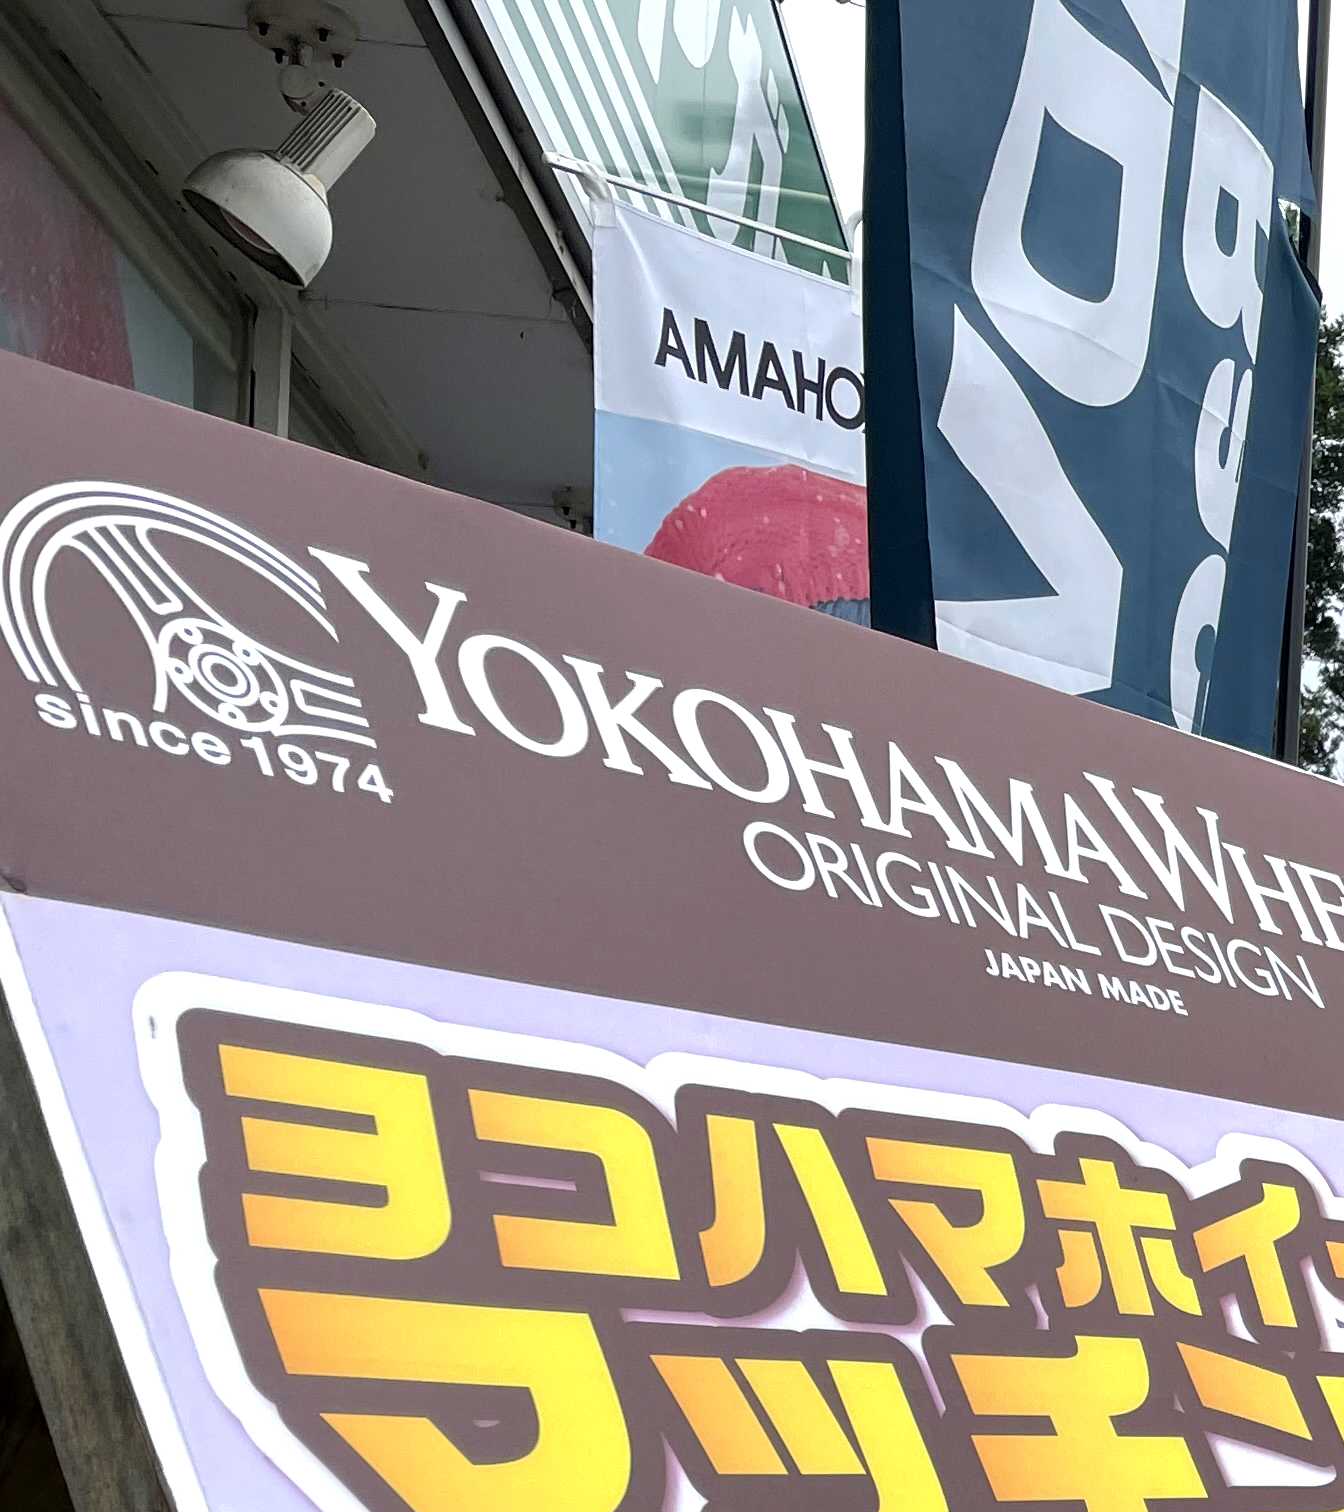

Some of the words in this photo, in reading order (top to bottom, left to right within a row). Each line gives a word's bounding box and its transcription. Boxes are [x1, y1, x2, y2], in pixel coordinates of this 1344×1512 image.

[654, 307, 867, 434] AMAHO
[33, 689, 232, 766] since
[241, 735, 395, 804] 1974
[308, 545, 1147, 900] YOKOHAMA
[743, 821, 1101, 956] ORIGINAL
[1098, 904, 1325, 1010] DESIGN
[984, 949, 1093, 995] JAPAN
[1096, 974, 1189, 1017] MADE
